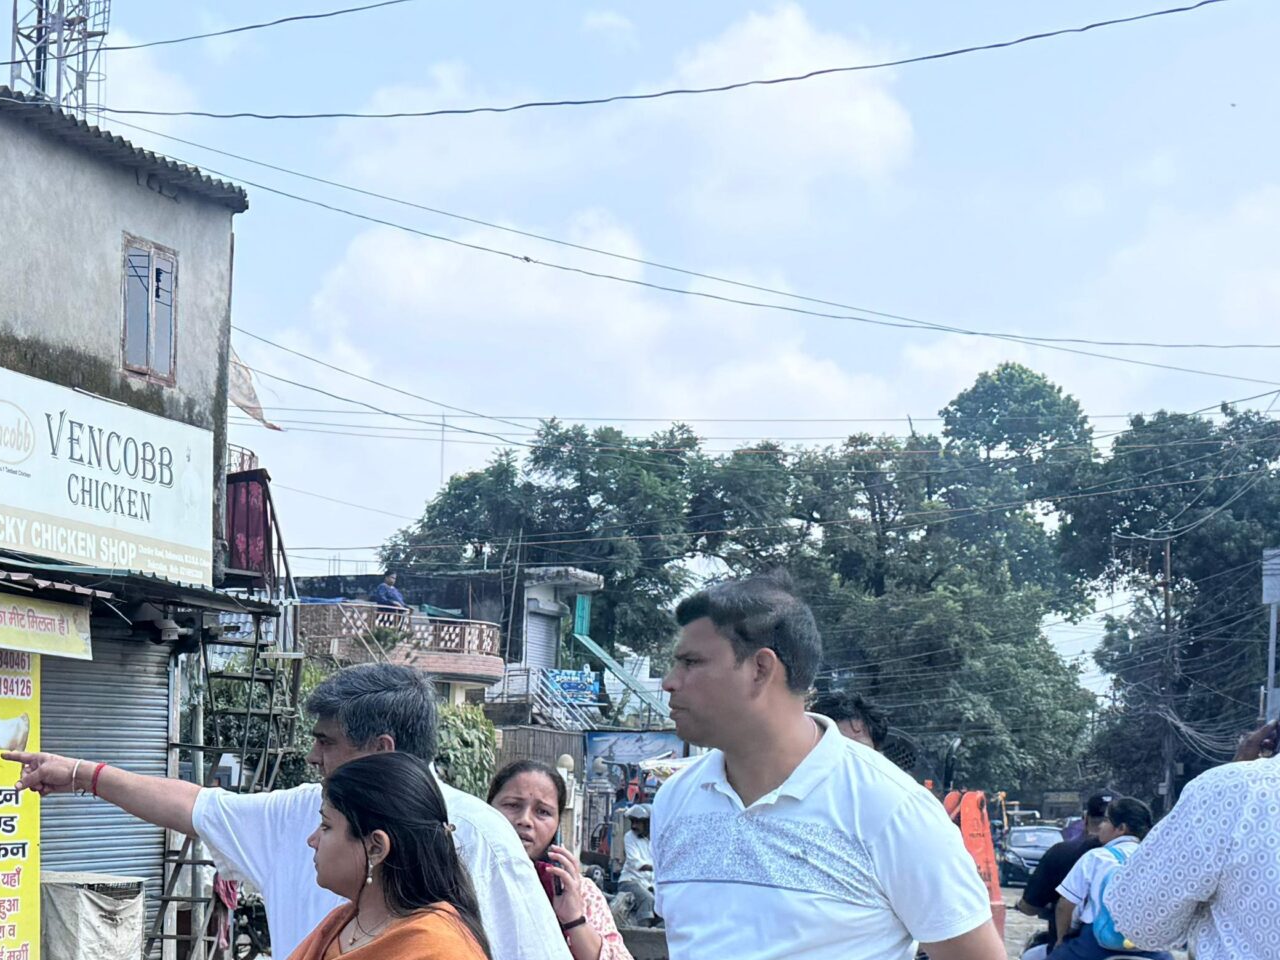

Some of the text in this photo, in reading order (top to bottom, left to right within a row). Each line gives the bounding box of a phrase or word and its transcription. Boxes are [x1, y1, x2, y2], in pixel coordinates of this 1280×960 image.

[67, 472, 151, 522] CHICKEN
[31, 521, 97, 560] CHICKEN
[100, 535, 137, 567] SHOP
[8, 606, 26, 629] मीट
[26, 608, 56, 633] मिलता
[1, 867, 21, 886] यहाँ
[8, 924, 16, 938] व
